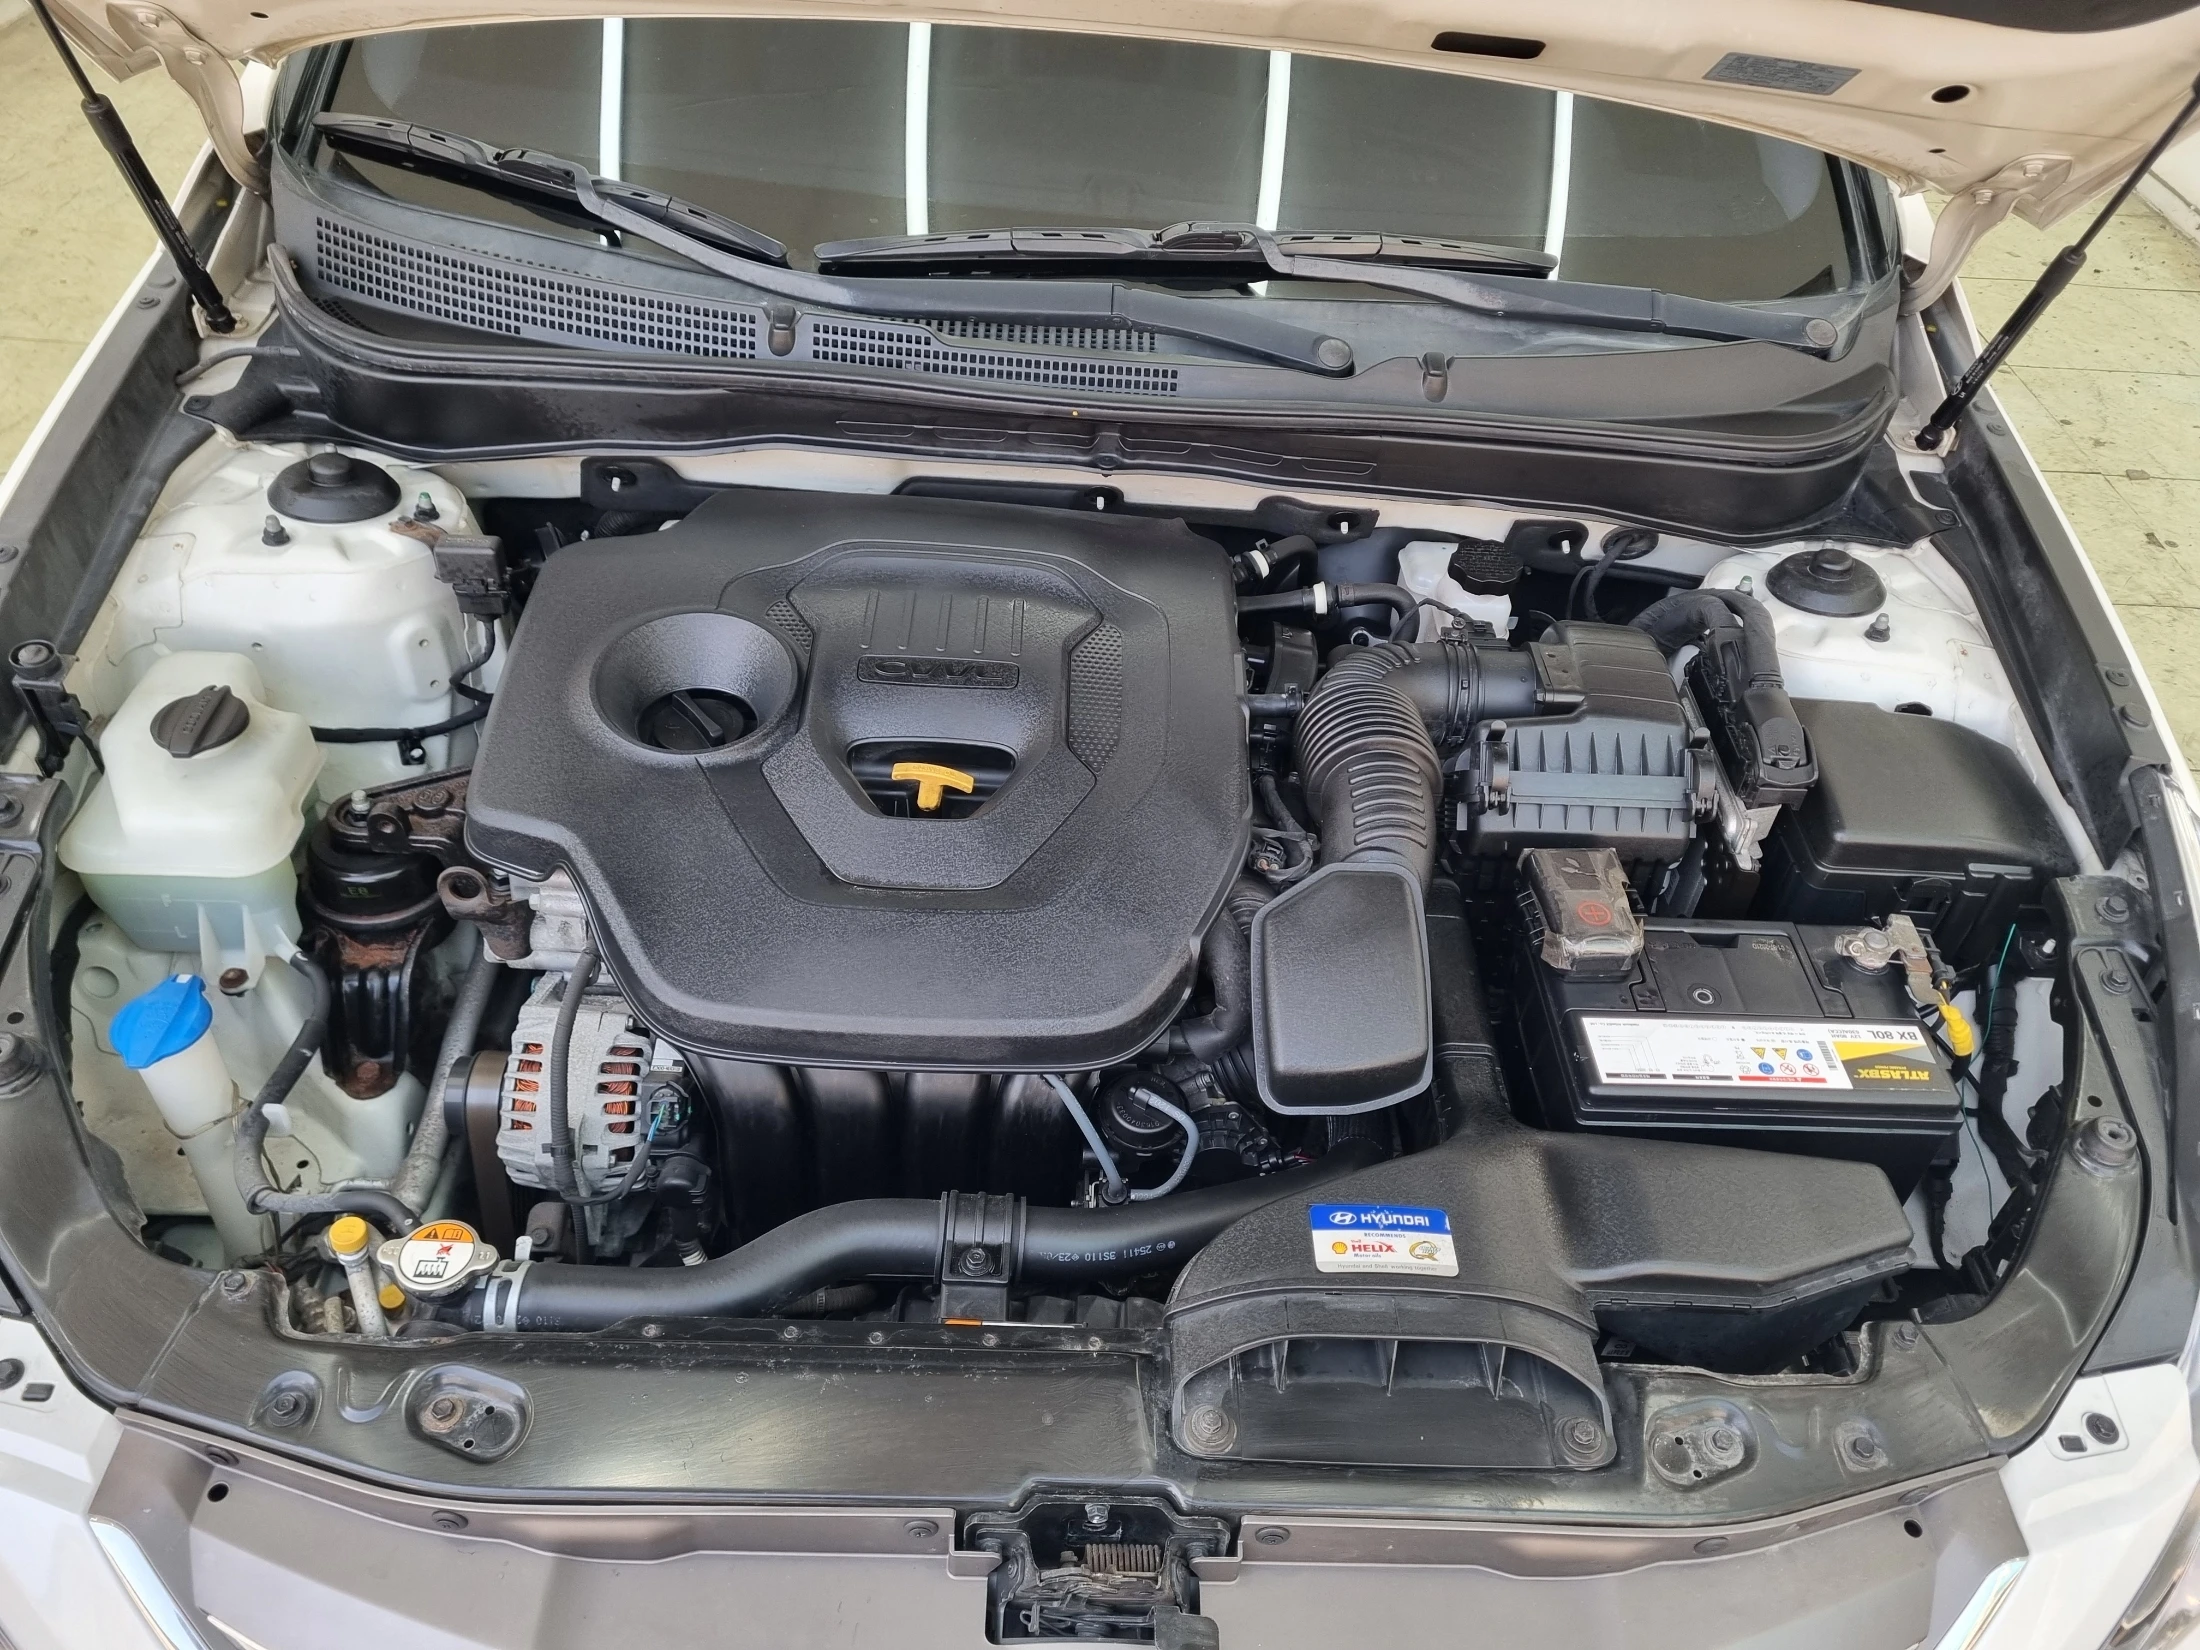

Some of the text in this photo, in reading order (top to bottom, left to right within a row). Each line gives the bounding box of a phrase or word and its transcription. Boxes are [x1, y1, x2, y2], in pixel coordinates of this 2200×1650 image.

[875, 661, 1003, 681] CVVL
[1866, 1030, 1919, 1041] BX 80L
[1857, 1068, 1930, 1081] ATLASBX
[1360, 1213, 1430, 1227] HYUNDAI
[1351, 1242, 1397, 1253] HELIX
[1085, 1251, 1116, 1261] 3S110
